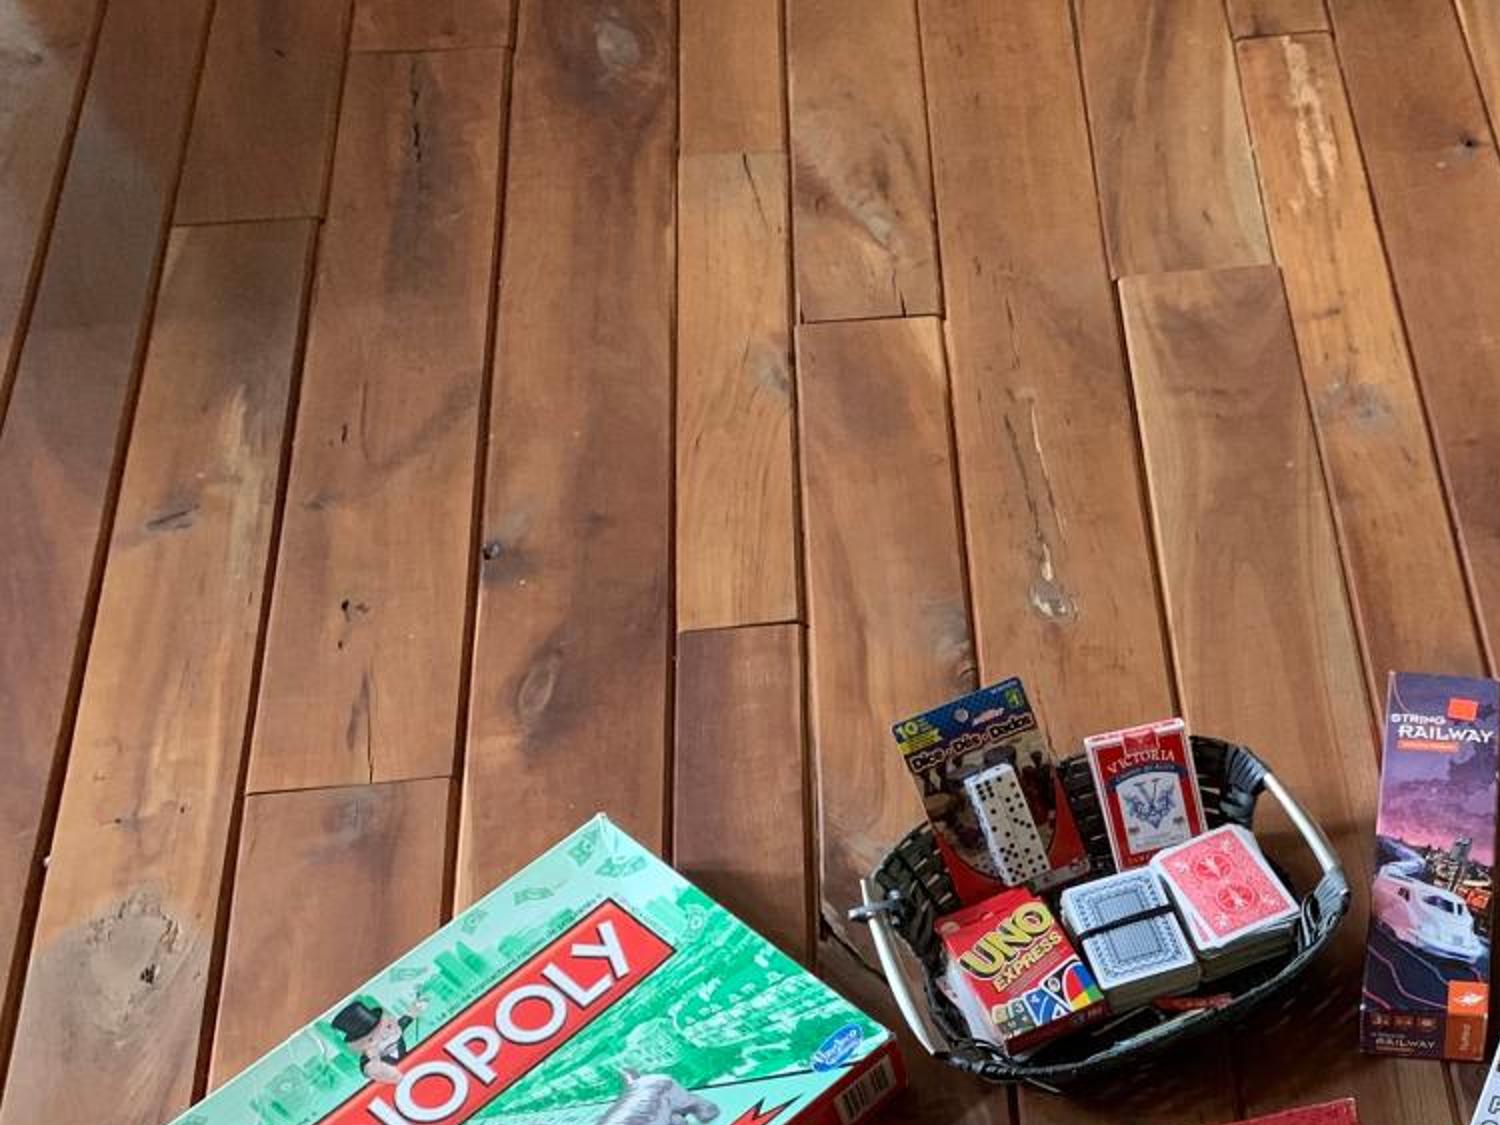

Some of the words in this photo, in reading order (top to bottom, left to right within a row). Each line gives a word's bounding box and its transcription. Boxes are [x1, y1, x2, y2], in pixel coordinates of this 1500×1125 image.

[1391, 713, 1447, 725] STRING
[1398, 725, 1494, 743] RAILWAY
[911, 751, 945, 771] Dice
[989, 714, 1033, 738] Dados
[1107, 750, 1175, 773] VICTORIA
[959, 901, 1054, 977] UNO
[993, 931, 1062, 992] EXPRESS
